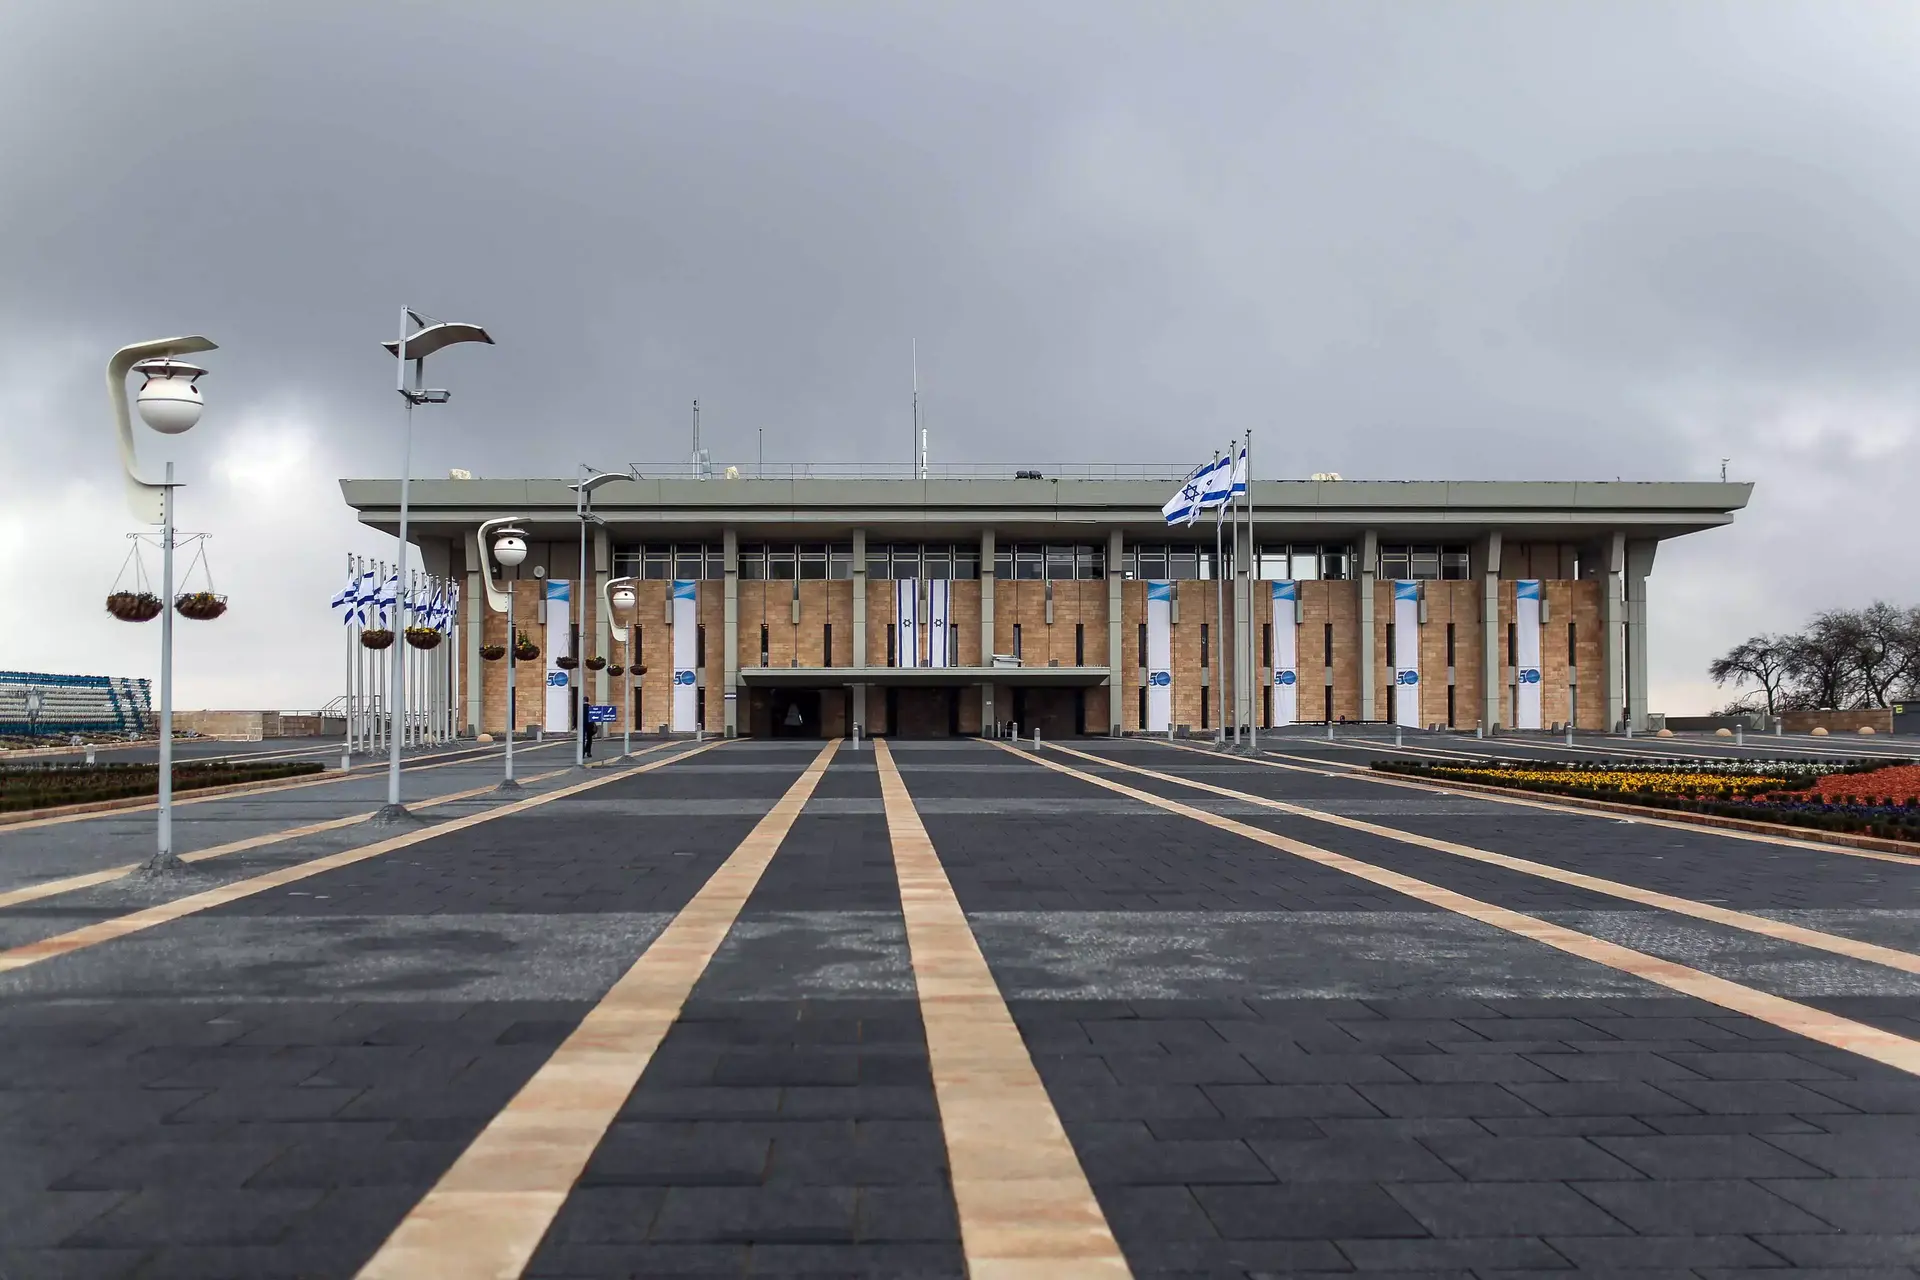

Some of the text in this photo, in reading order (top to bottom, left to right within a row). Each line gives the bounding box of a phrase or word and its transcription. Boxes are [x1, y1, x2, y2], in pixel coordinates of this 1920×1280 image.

[546, 671, 569, 687] 50
[673, 670, 696, 686] 50
[1149, 671, 1171, 687] 50
[1274, 670, 1297, 686] 50
[1396, 669, 1419, 686] 50
[1518, 668, 1541, 684] 50
